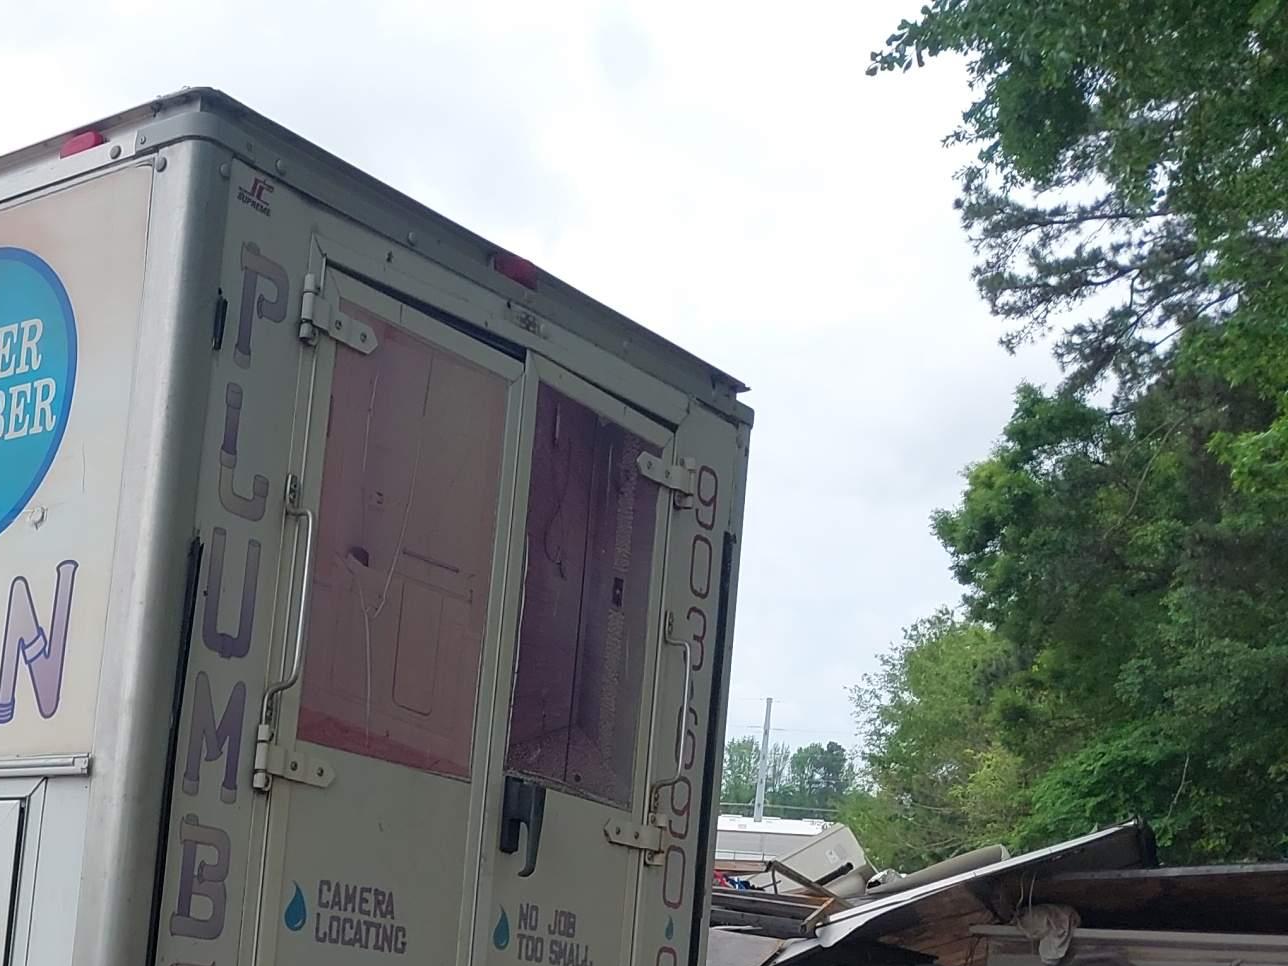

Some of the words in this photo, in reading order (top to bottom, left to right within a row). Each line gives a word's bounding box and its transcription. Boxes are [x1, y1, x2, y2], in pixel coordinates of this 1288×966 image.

[317, 879, 395, 920] CAMERA
[314, 912, 407, 954] LOCATING
[517, 903, 539, 931] NO
[548, 909, 576, 938] JOB
[516, 933, 544, 963] TOO
